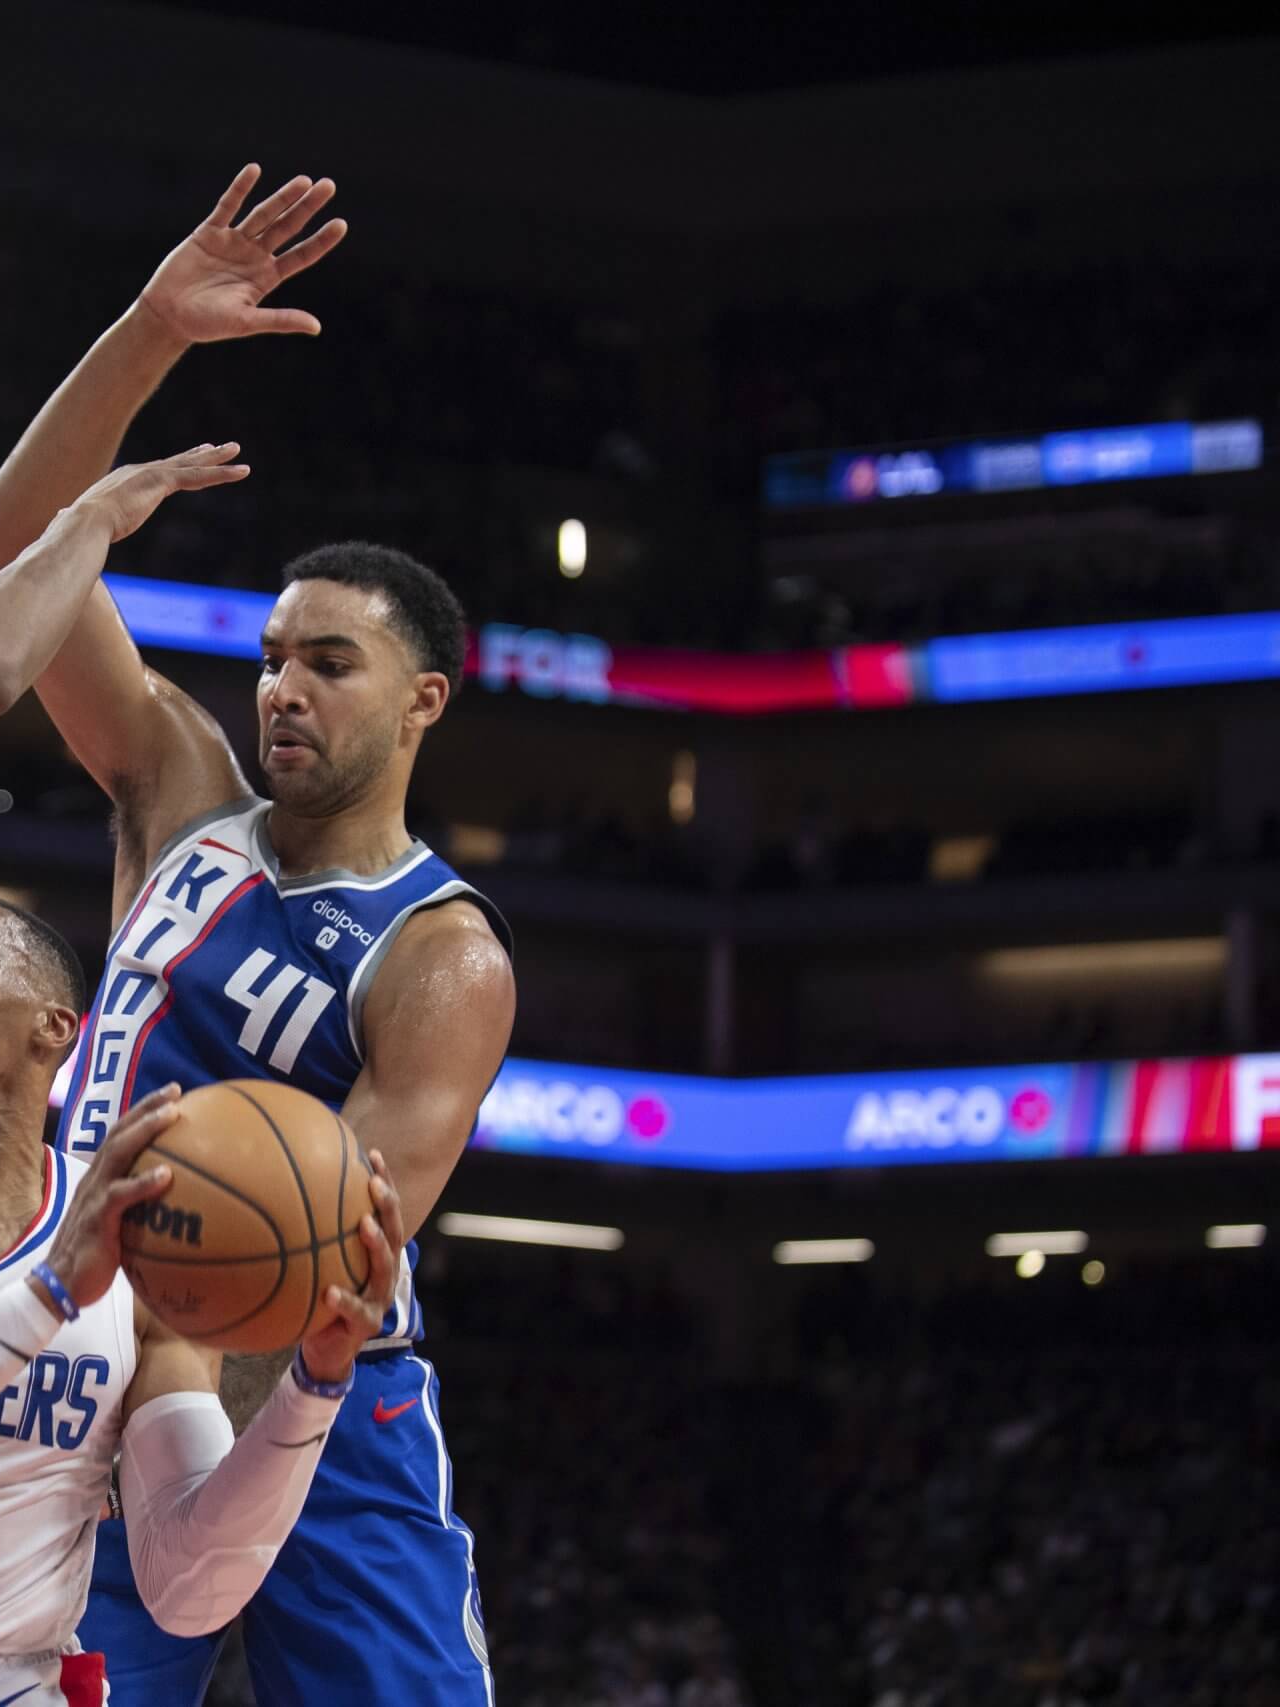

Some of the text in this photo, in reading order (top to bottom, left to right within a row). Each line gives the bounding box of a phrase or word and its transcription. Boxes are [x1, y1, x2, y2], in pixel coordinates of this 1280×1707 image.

[480, 622, 613, 706] FOR
[312, 899, 375, 946] dialpad
[72, 851, 228, 1151] KINGS
[223, 947, 337, 1075] 41
[844, 1085, 1005, 1151] ARCO
